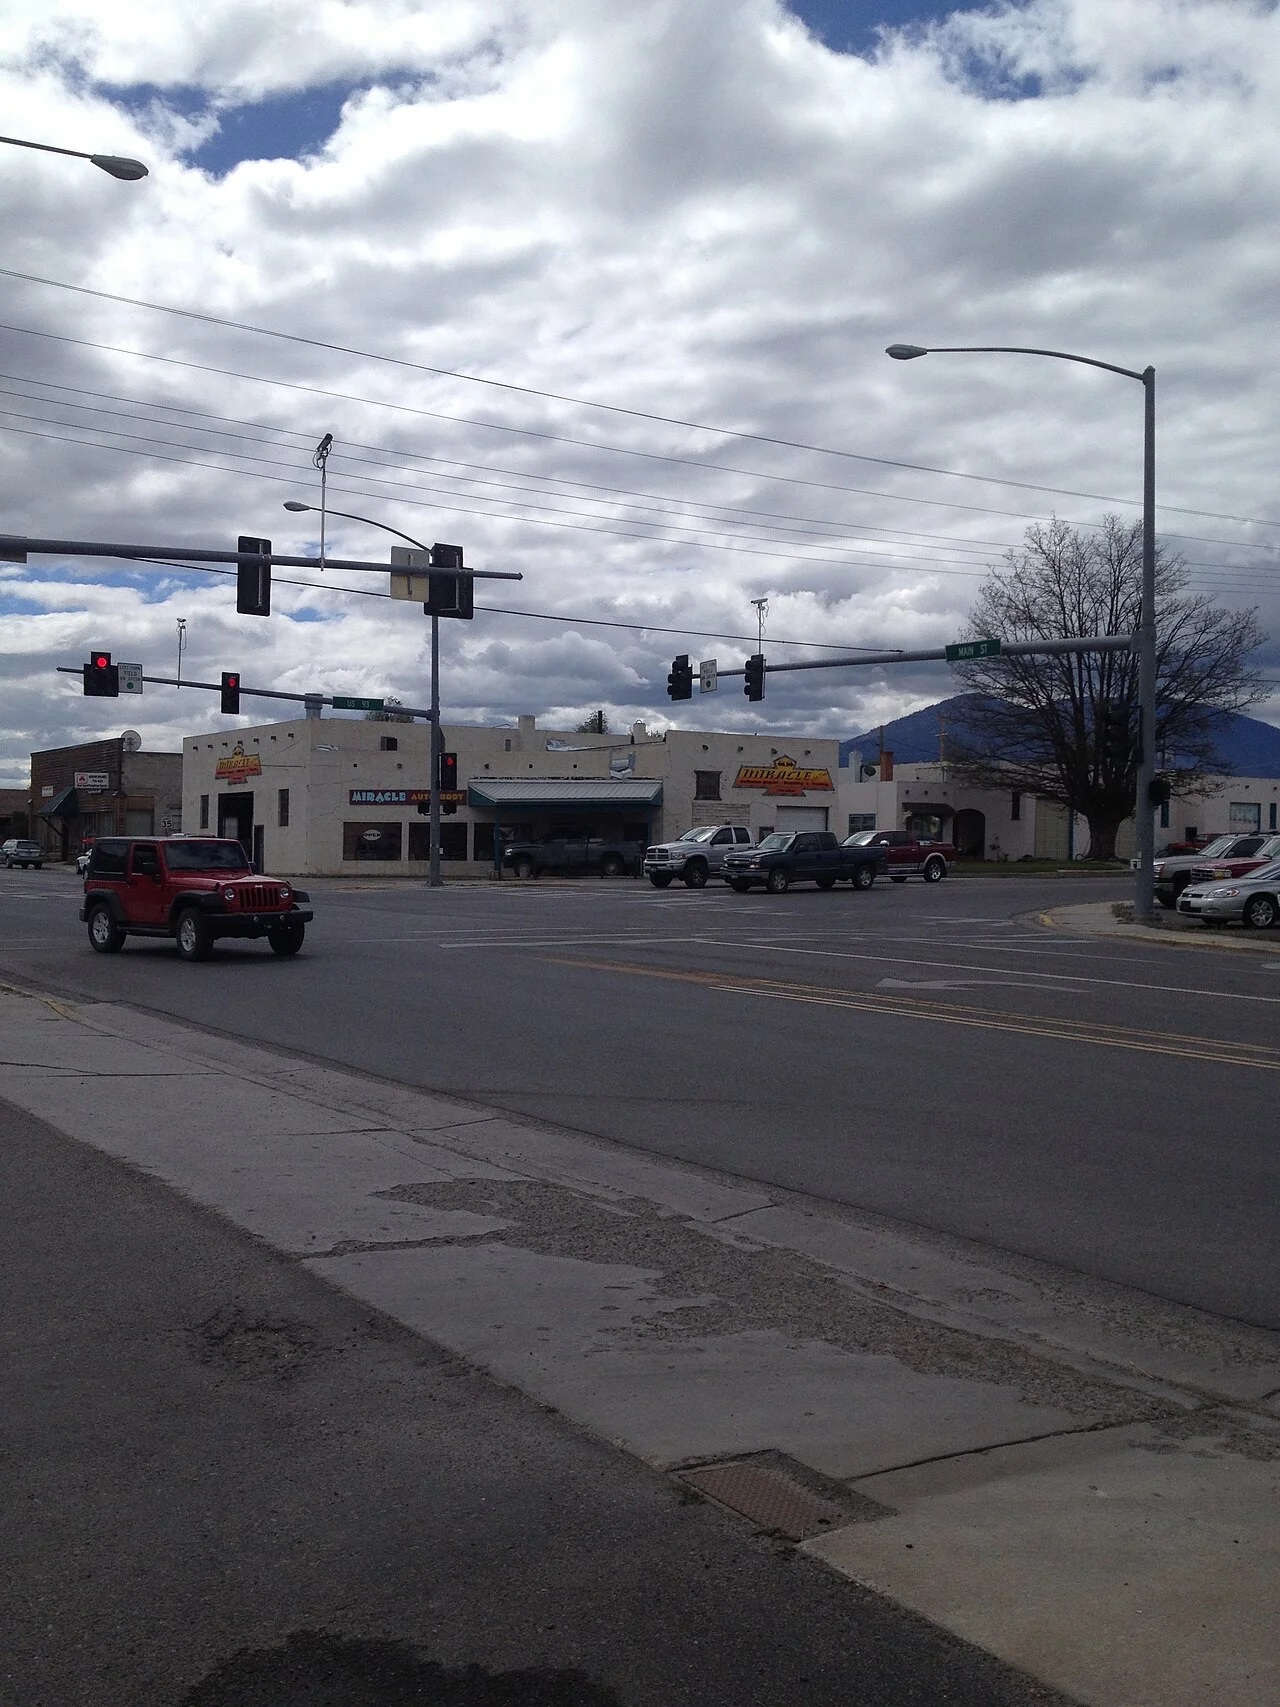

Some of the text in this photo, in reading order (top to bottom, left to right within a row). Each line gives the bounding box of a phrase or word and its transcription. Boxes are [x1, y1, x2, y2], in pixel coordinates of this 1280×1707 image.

[958, 643, 988, 657] MAIN ST
[346, 699, 370, 709] US 93
[743, 768, 812, 781] MIRACLE
[351, 791, 407, 803] MIRACLE
[439, 793, 464, 801] BODY
[161, 820, 172, 828] 35
